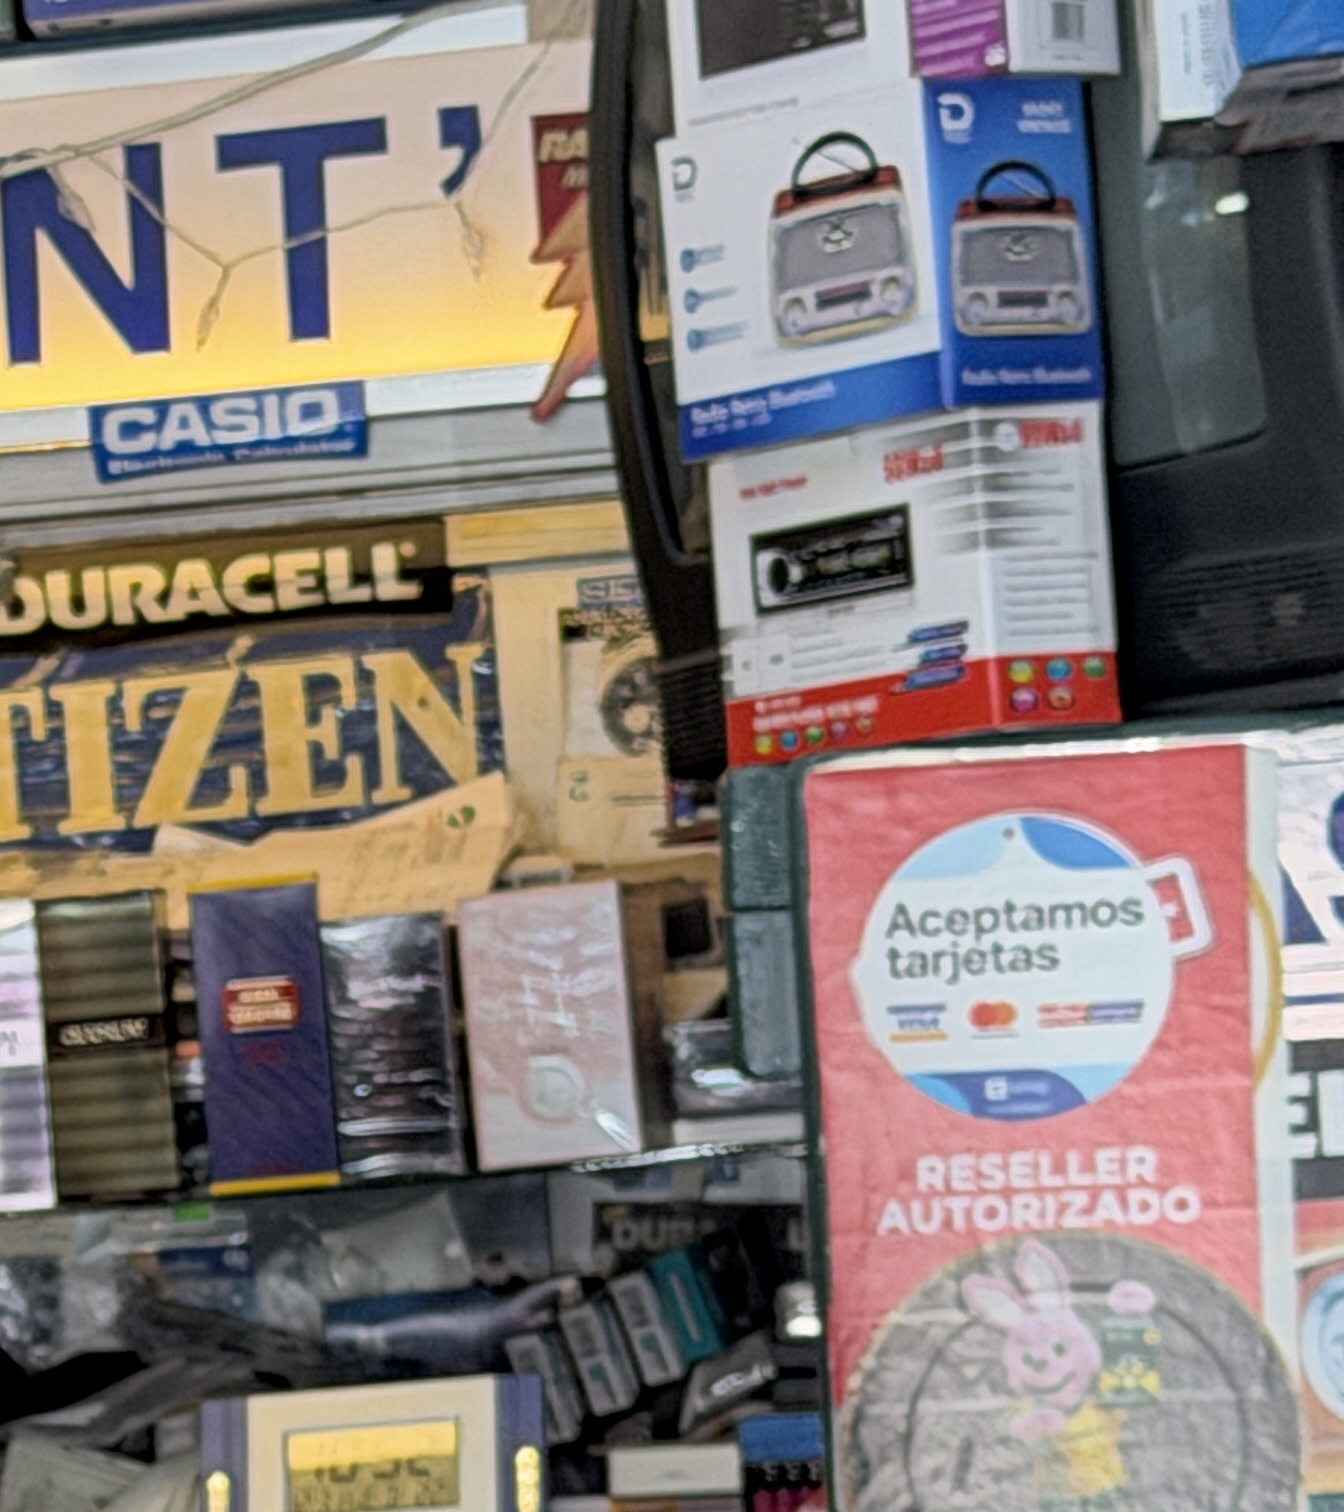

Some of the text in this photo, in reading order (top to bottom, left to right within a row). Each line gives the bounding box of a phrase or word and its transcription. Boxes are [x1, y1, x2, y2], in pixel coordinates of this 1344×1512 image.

[101, 389, 340, 456] CASIO
[885, 897, 1145, 943] Aceptamos
[887, 939, 1061, 986] tarjetas
[916, 1145, 1158, 1194] RESELLER
[877, 1185, 1201, 1237] AUTORIZADO
